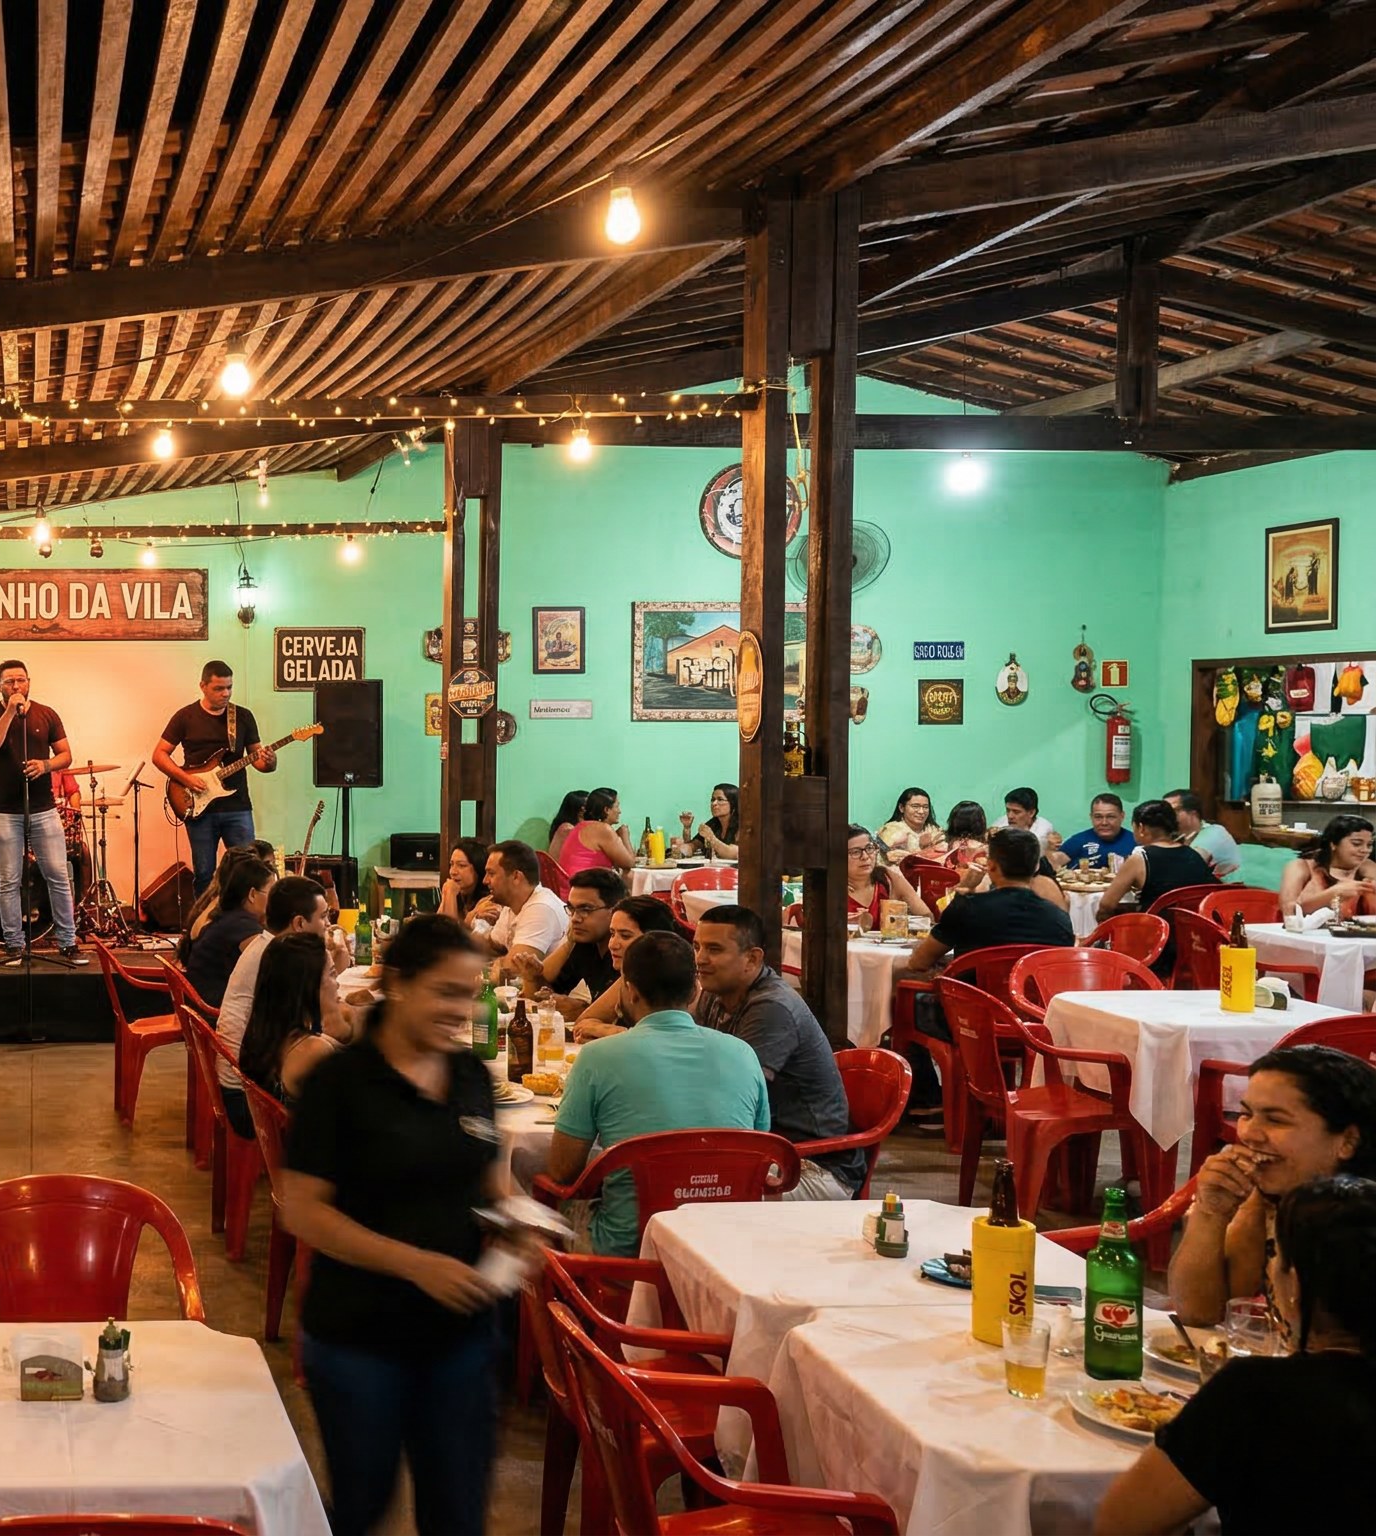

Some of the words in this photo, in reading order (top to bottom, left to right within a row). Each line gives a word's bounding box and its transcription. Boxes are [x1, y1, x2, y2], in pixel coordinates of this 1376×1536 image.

[68, 582, 111, 619] DA
[120, 582, 193, 619] VILA
[281, 636, 359, 657] CERVEJA
[283, 659, 357, 682] GELADA
[1008, 1271, 1027, 1317] SKOL
